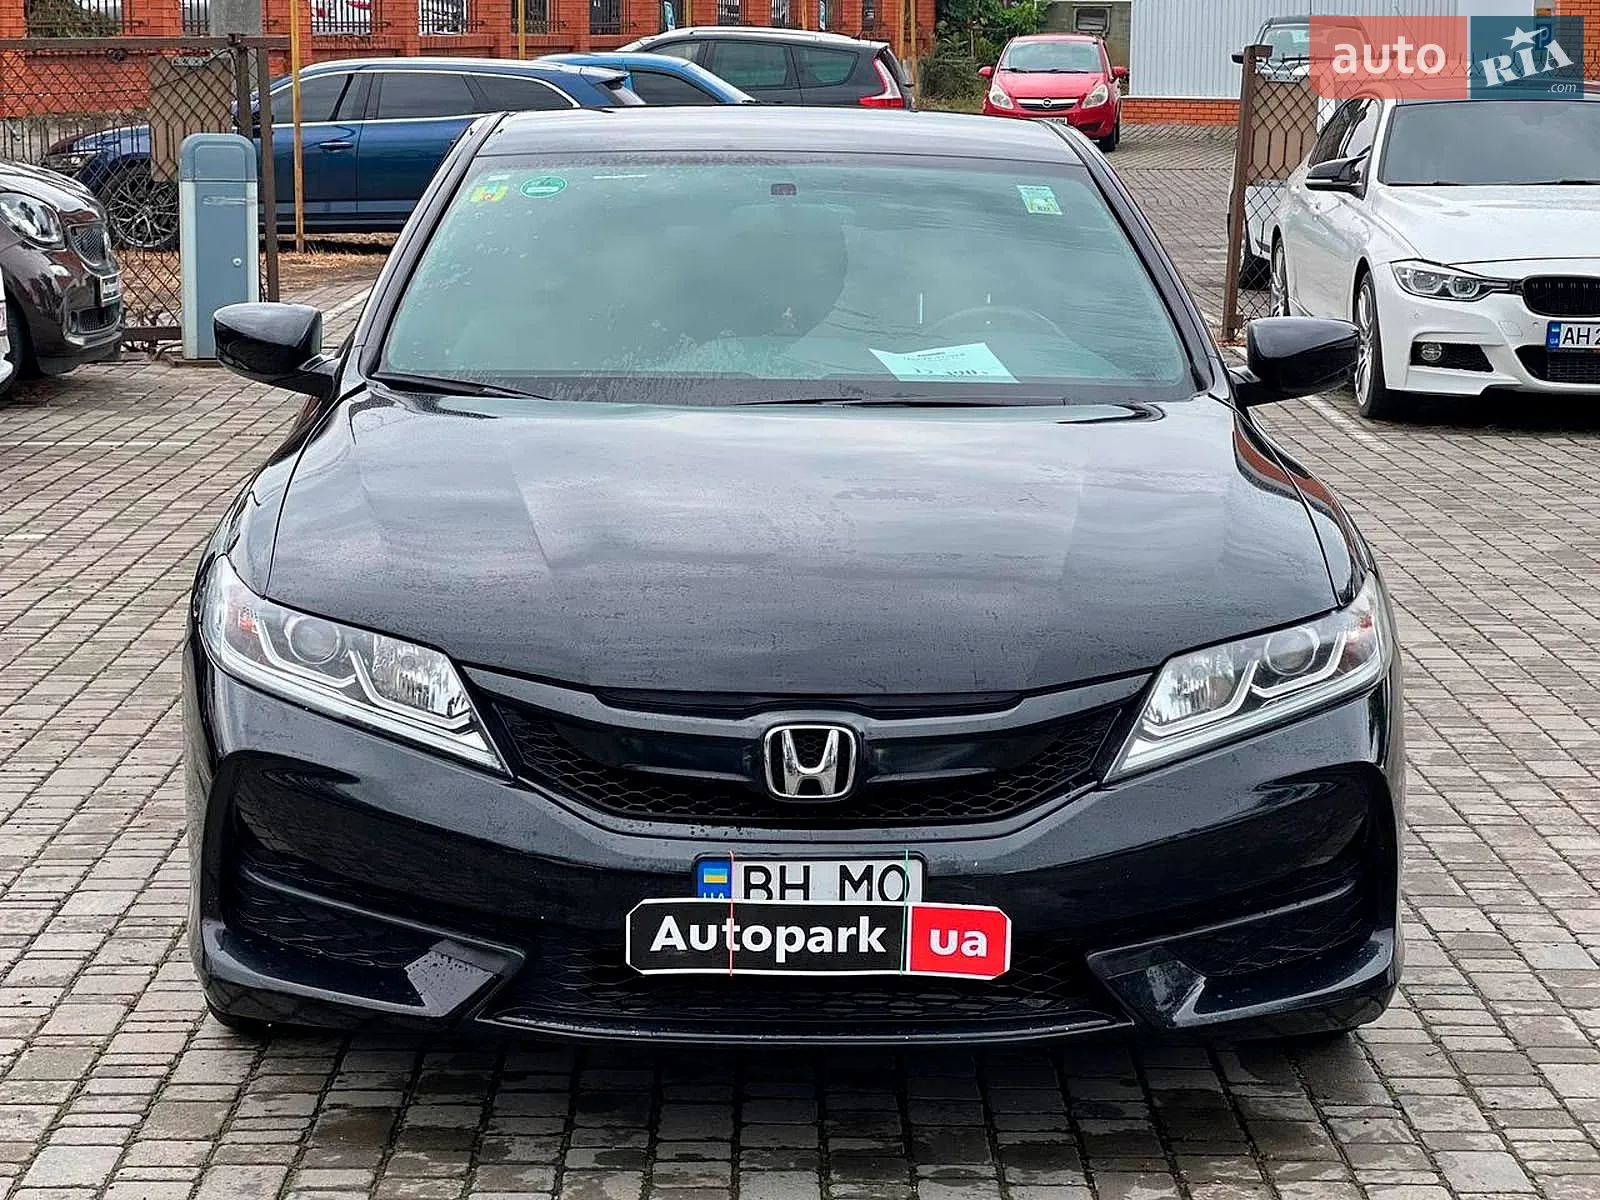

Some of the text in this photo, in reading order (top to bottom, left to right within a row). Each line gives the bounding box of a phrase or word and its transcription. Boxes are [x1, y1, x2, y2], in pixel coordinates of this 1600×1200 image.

[1562, 327, 1591, 345] AH
[743, 864, 910, 902] BH MO
[649, 915, 989, 963] Autopark ua
